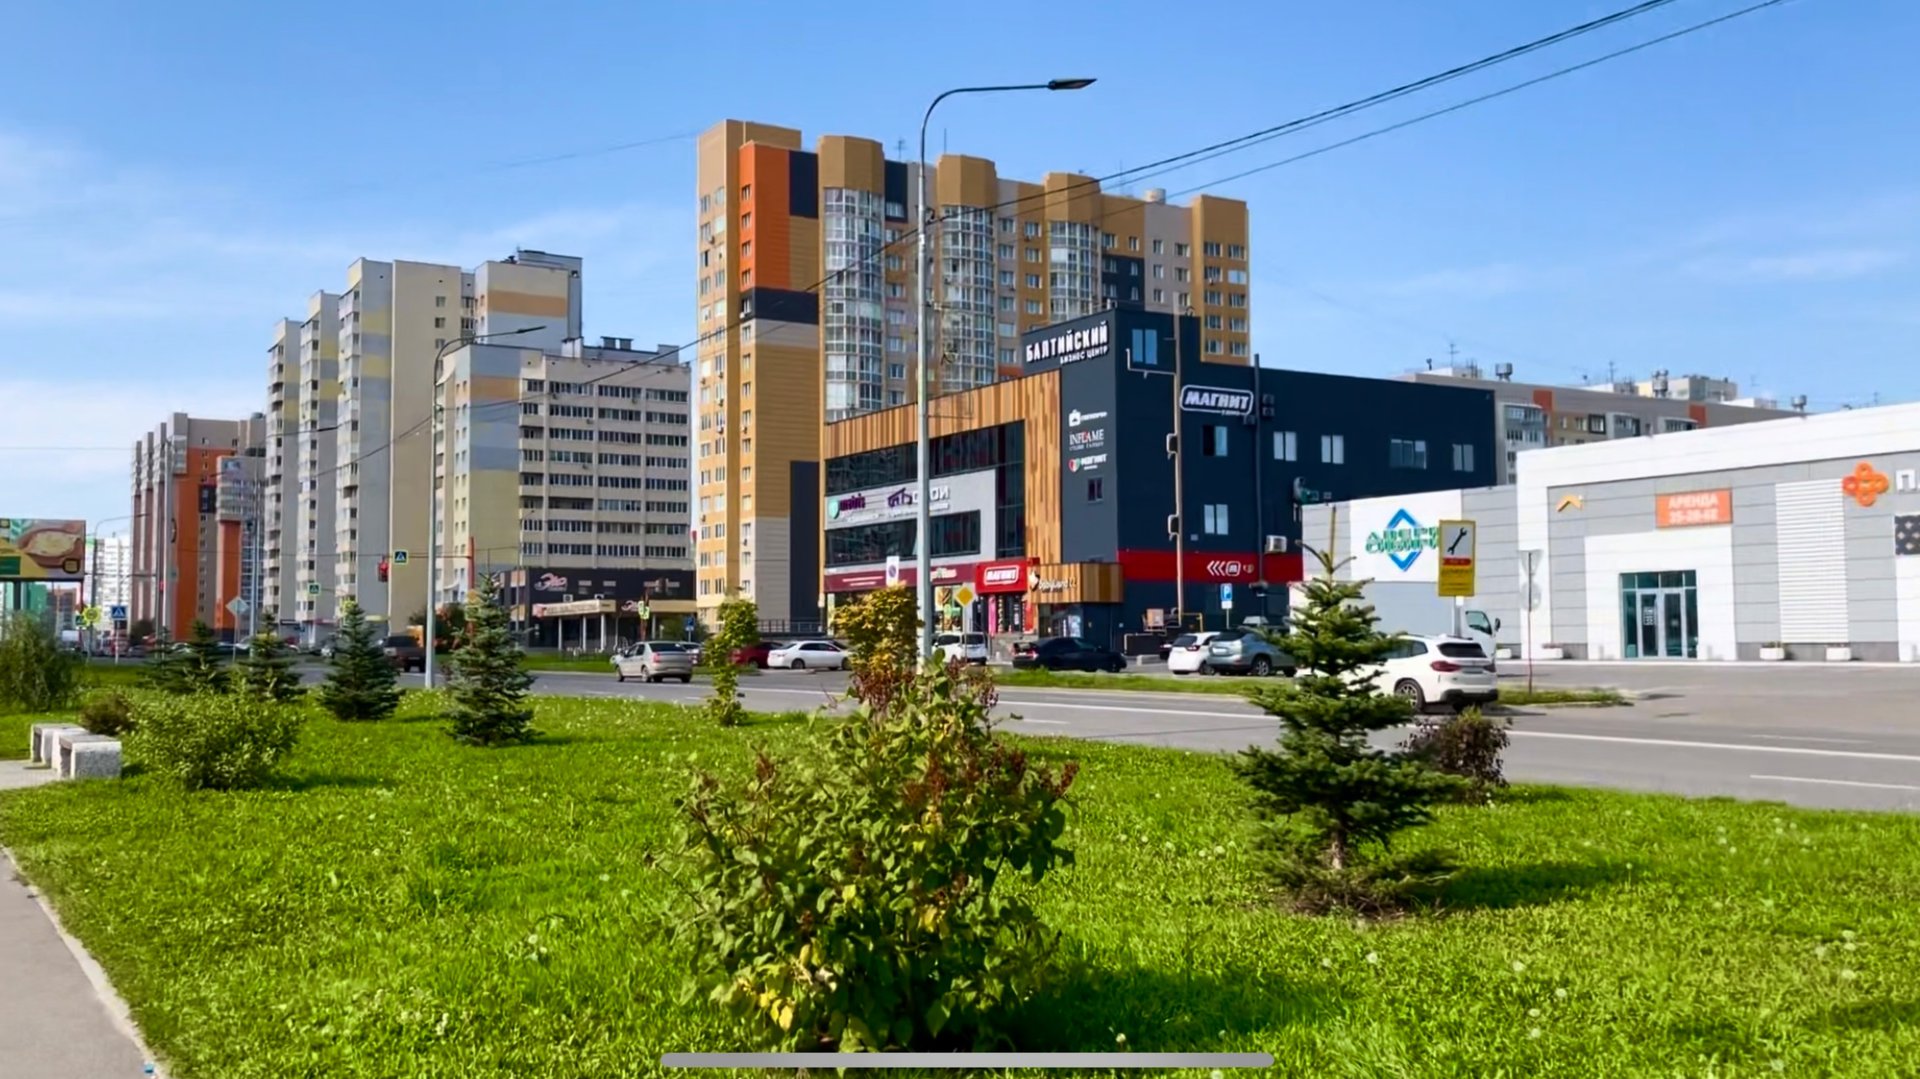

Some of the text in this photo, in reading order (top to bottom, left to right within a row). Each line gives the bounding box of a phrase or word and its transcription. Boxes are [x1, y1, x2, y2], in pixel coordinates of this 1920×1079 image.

[1026, 320, 1108, 363] БАЛТИЙСКИЙ
[1060, 345, 1108, 365] БИЗНЕС ЦЕНТР
[1185, 391, 1249, 410] МАГНИТ
[1667, 493, 1719, 510] АРЕНДА
